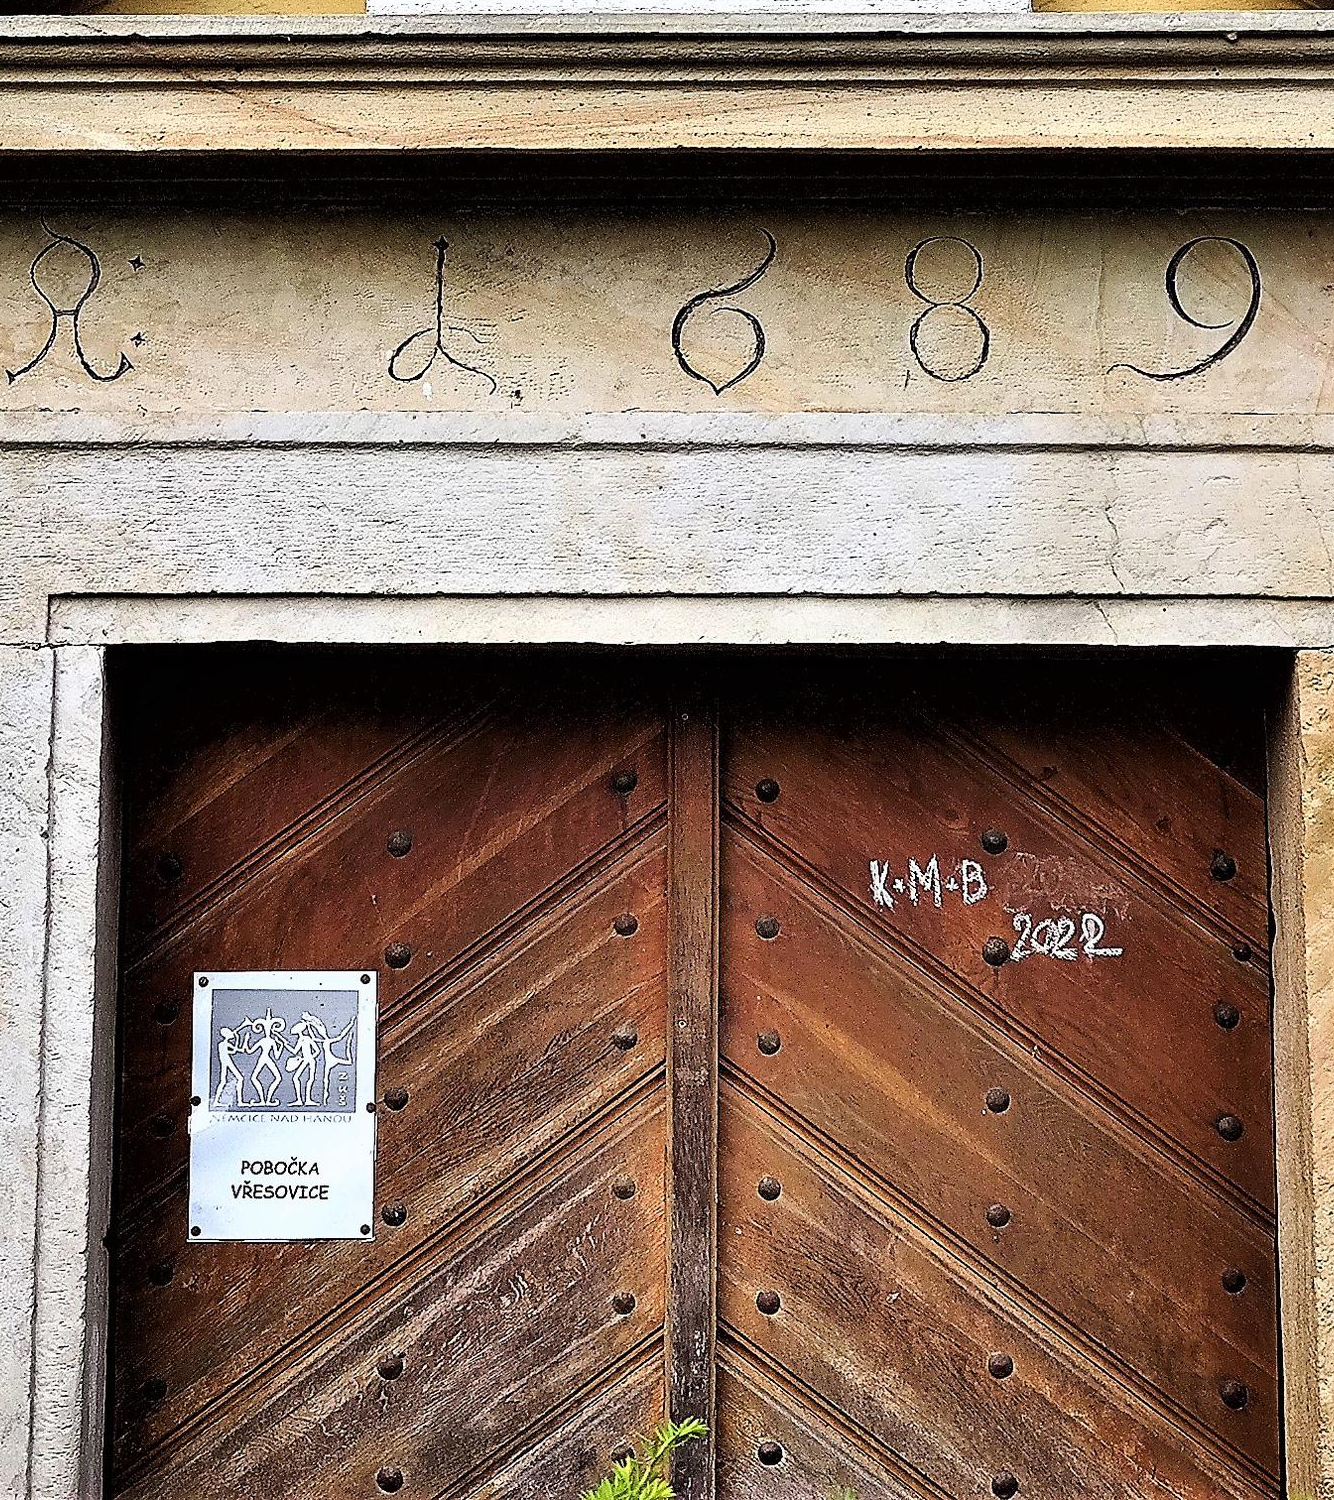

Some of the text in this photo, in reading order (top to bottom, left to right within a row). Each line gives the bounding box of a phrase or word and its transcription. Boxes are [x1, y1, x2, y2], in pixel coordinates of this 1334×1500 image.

[270, 1114, 299, 1123] NAD
[240, 1156, 320, 1177] POBOČKA
[231, 1180, 330, 1200] VŘESOVICE
